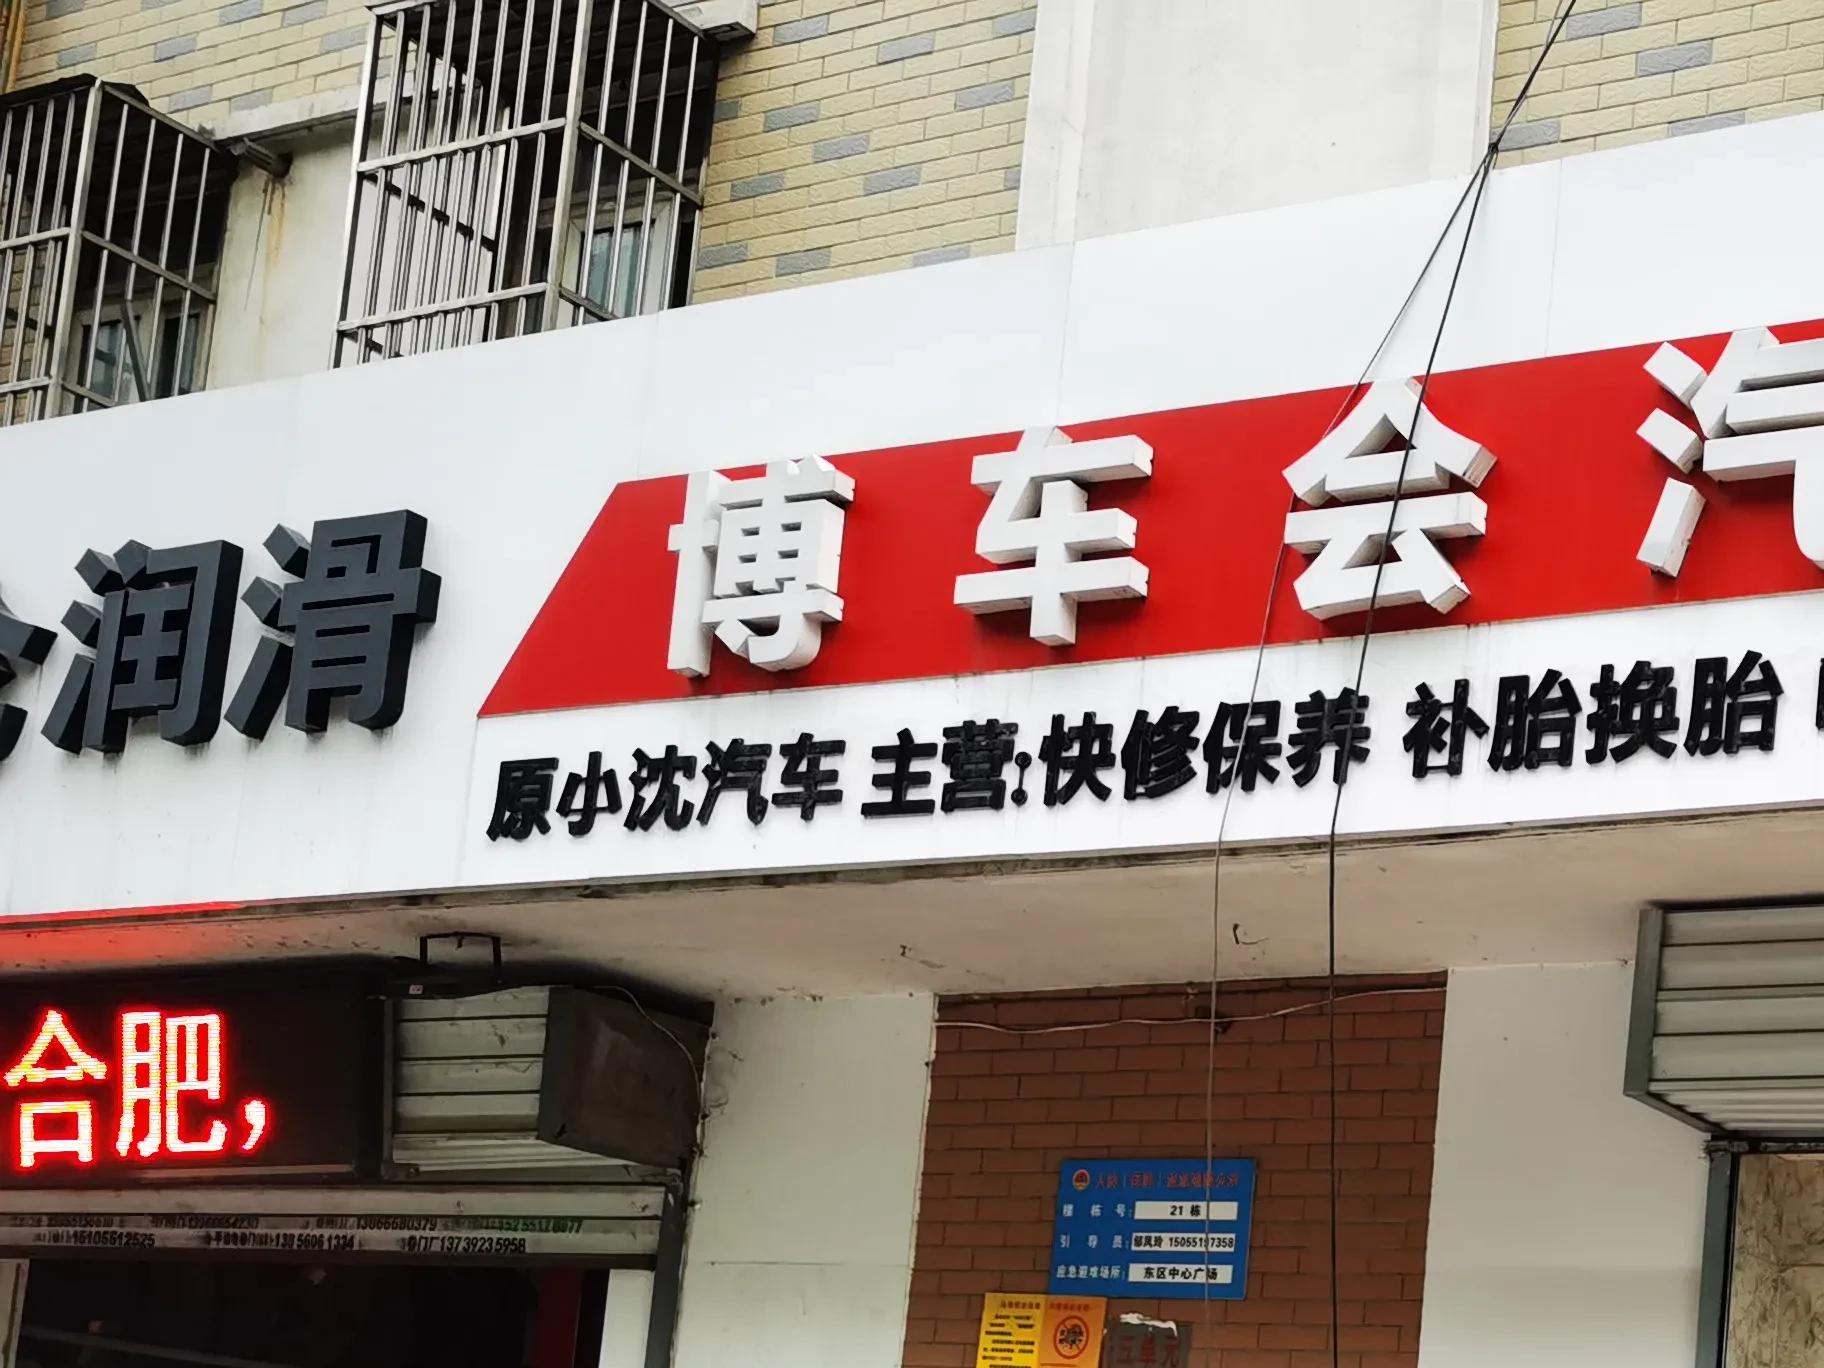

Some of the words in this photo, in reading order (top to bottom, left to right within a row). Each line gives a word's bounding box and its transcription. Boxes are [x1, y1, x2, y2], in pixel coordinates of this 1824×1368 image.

[485, 732, 846, 842] 原小沈汽车
[1403, 650, 1785, 779] 补胎换胎
[1143, 1266, 1218, 1281] 东区中心广场
